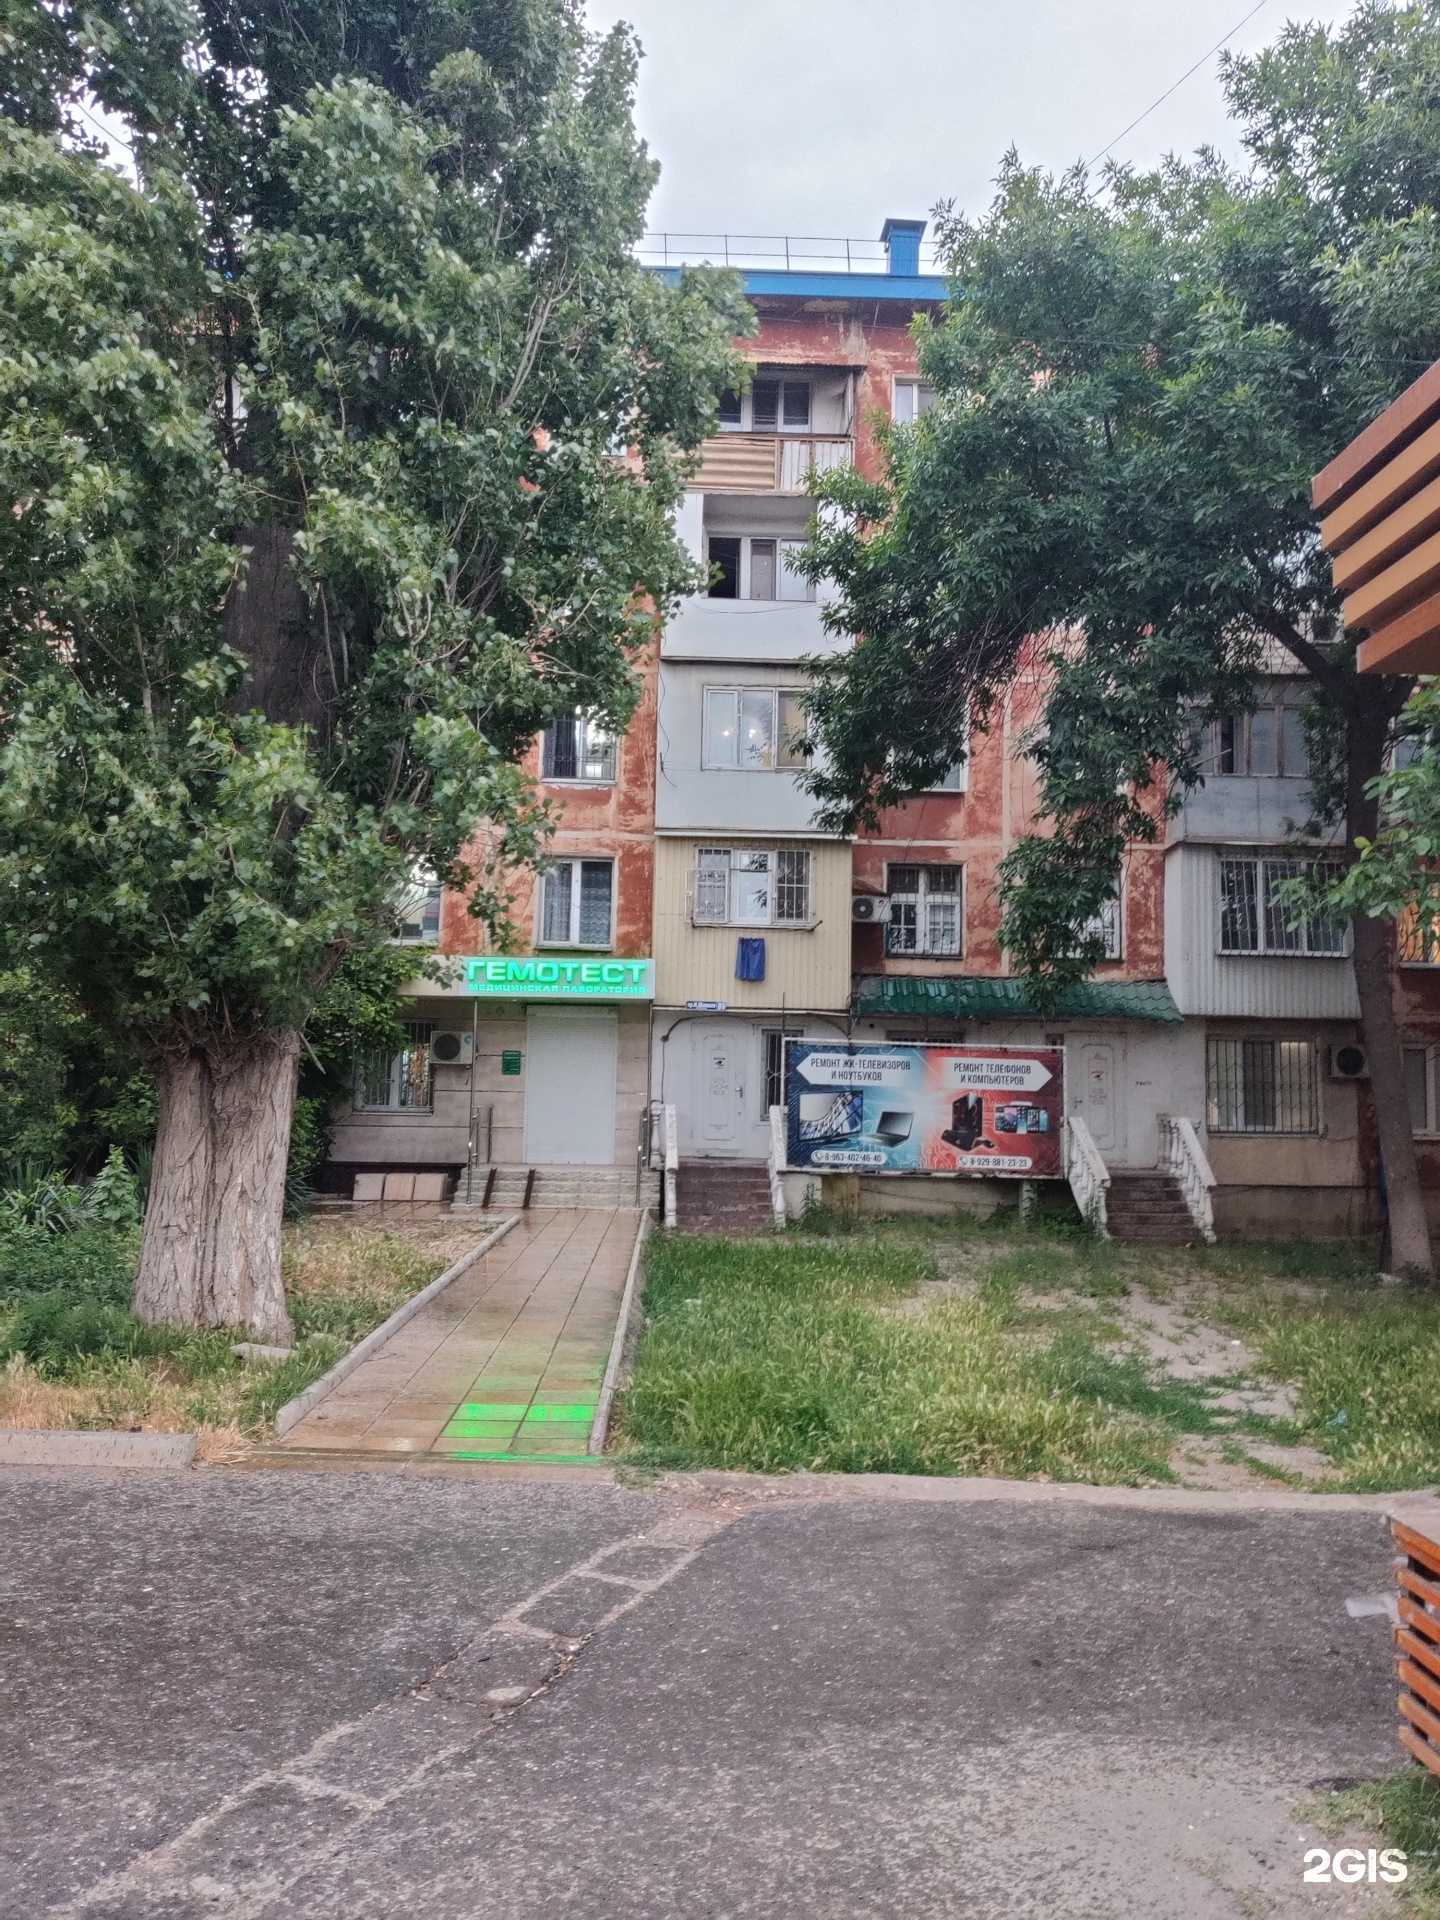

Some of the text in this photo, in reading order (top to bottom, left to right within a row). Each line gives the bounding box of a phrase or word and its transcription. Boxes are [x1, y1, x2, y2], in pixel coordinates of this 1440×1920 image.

[467, 960, 647, 984] ГЕМОТЕСТ
[469, 984, 647, 994] МЕДИЦИНСКАЯ ЛАБОРАТОРИЯ
[811, 1058, 911, 1070] РЕМОНТ ЖК-ТЕЛЕВИЗОРОВ
[954, 1063, 1031, 1074] РЕМОНТ ТЕЛЕФОНОВ
[831, 1071, 882, 1081] И НОУТБУКОВ
[960, 1074, 1024, 1085] И КОМПЬЮТЕРОВ
